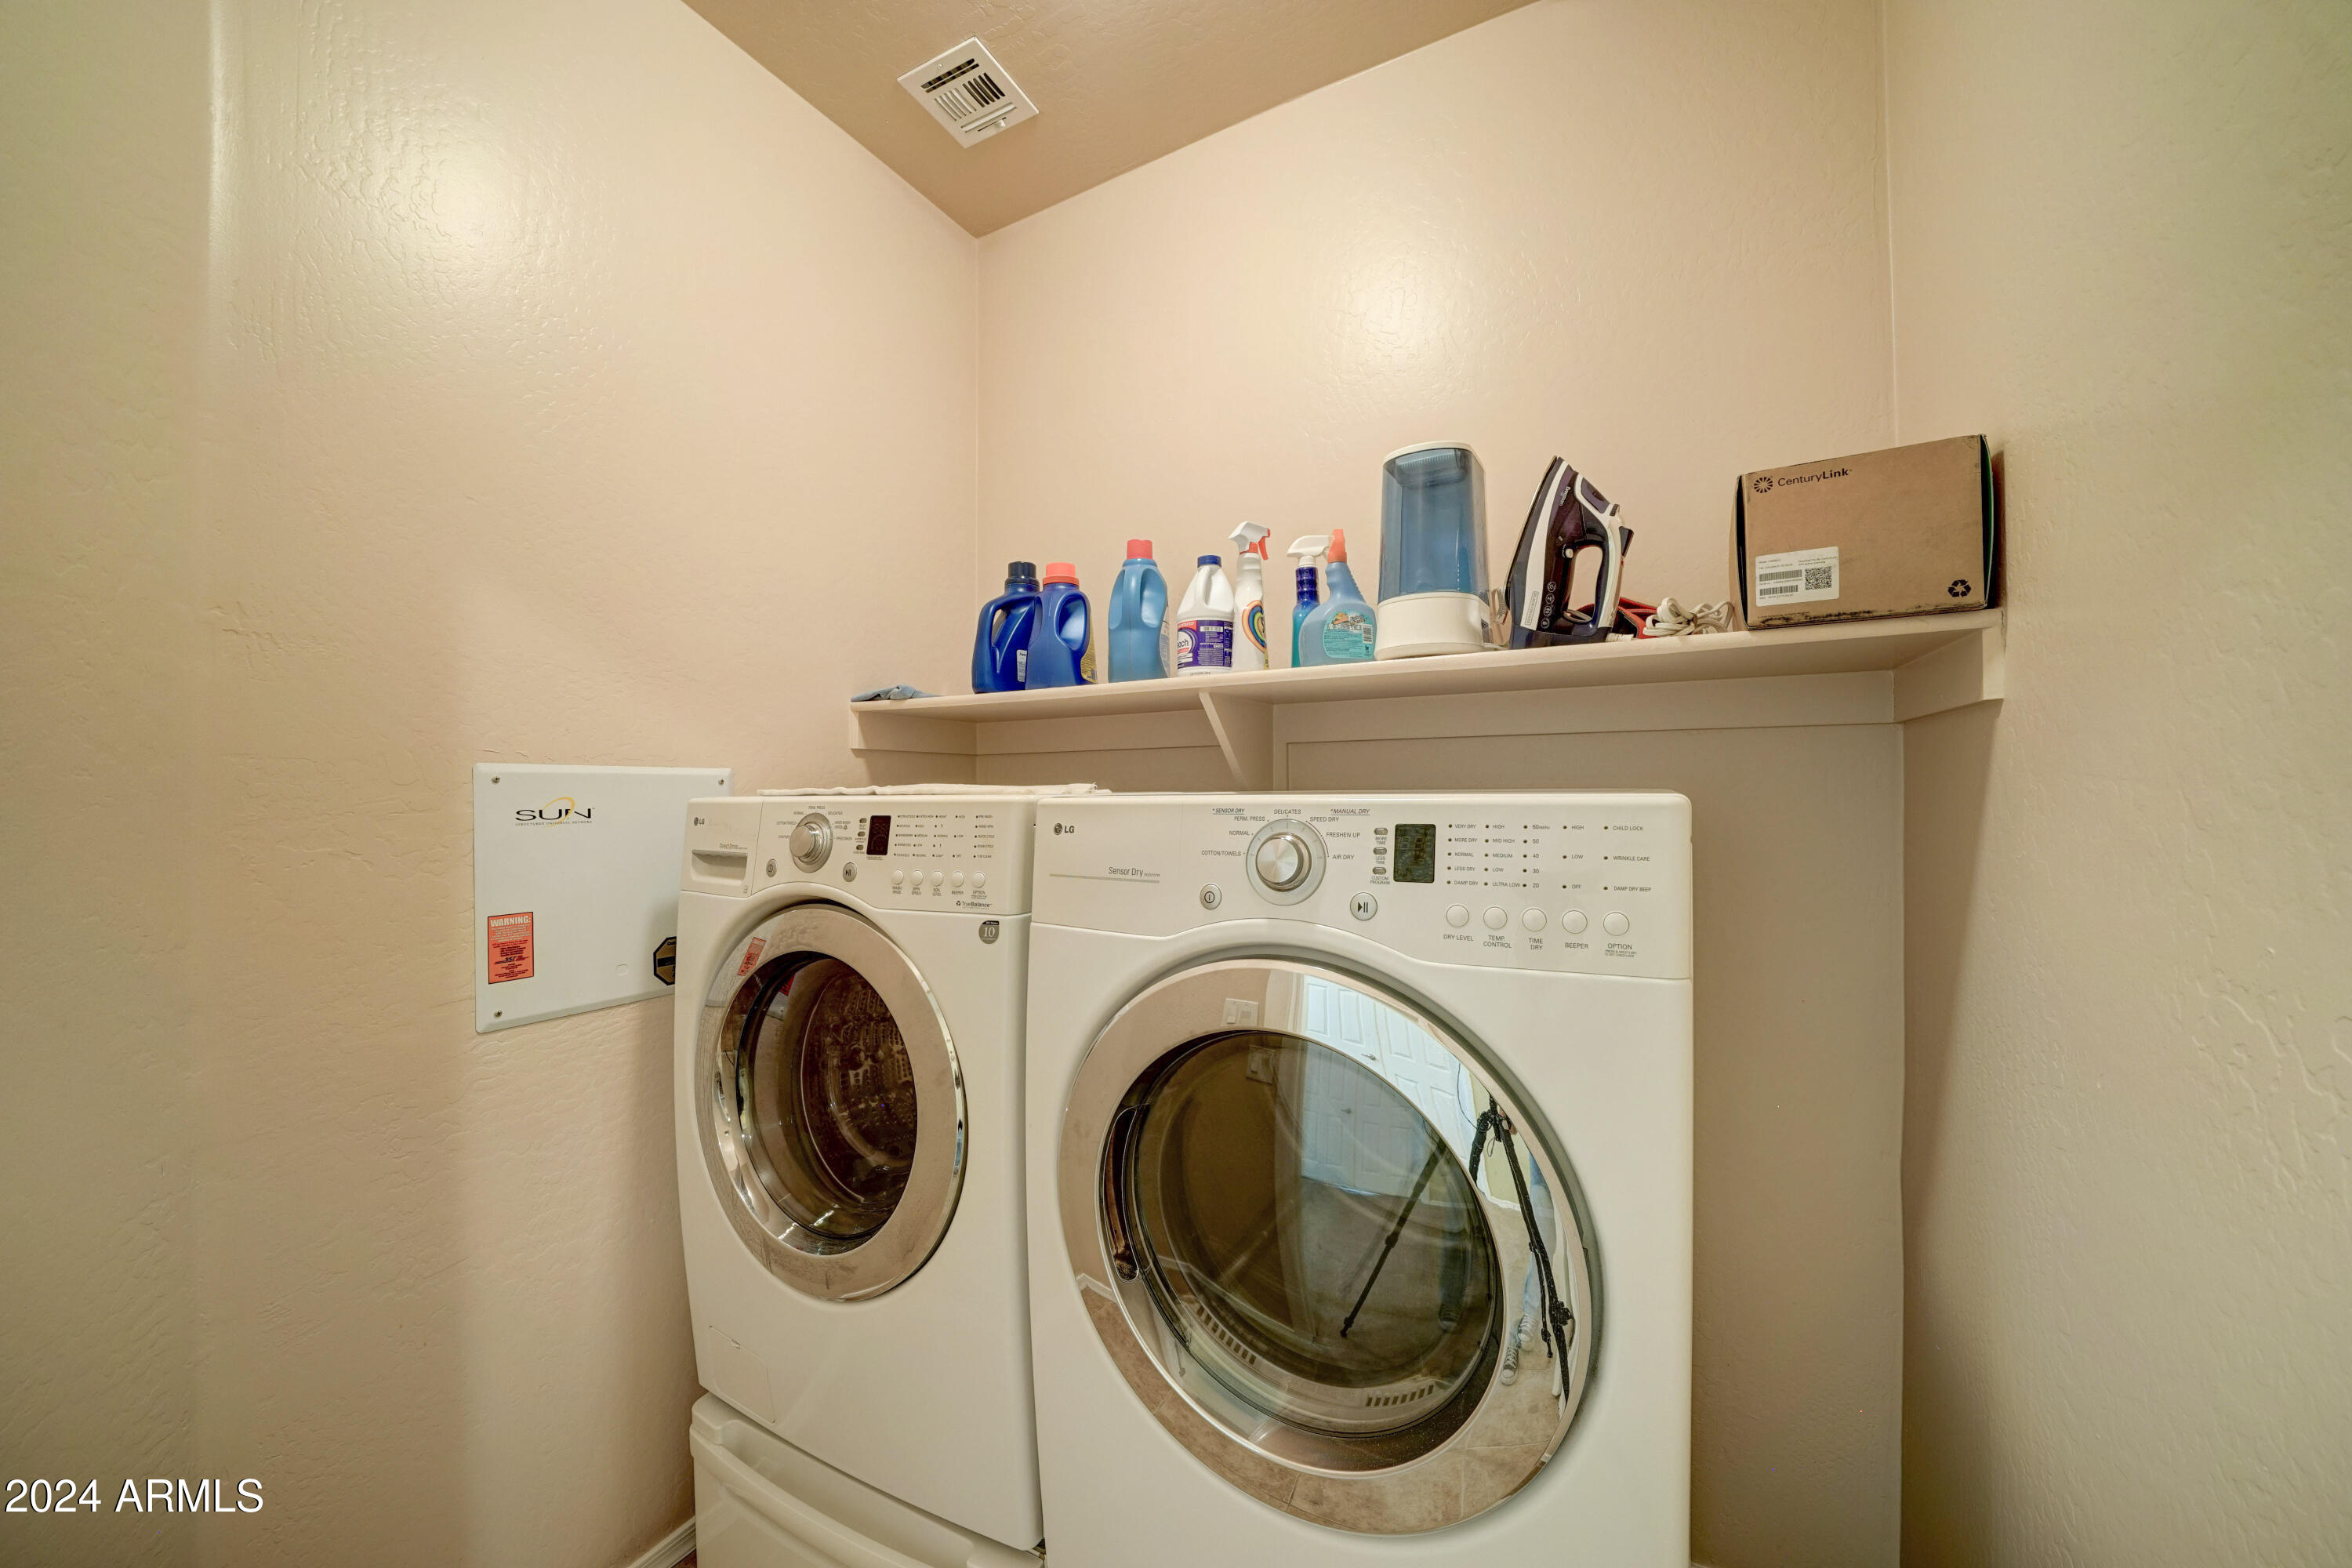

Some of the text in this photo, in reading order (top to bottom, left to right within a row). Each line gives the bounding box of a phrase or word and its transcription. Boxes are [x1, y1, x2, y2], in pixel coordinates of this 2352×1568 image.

[1777, 468, 1849, 487] CenturyLink
[515, 808, 591, 821] SUN
[1064, 825, 1075, 833] LG
[1109, 867, 1131, 876] Sensor
[1131, 867, 1144, 878] Dry
[490, 916, 532, 927] WARNING:
[983, 927, 995, 938] 10
